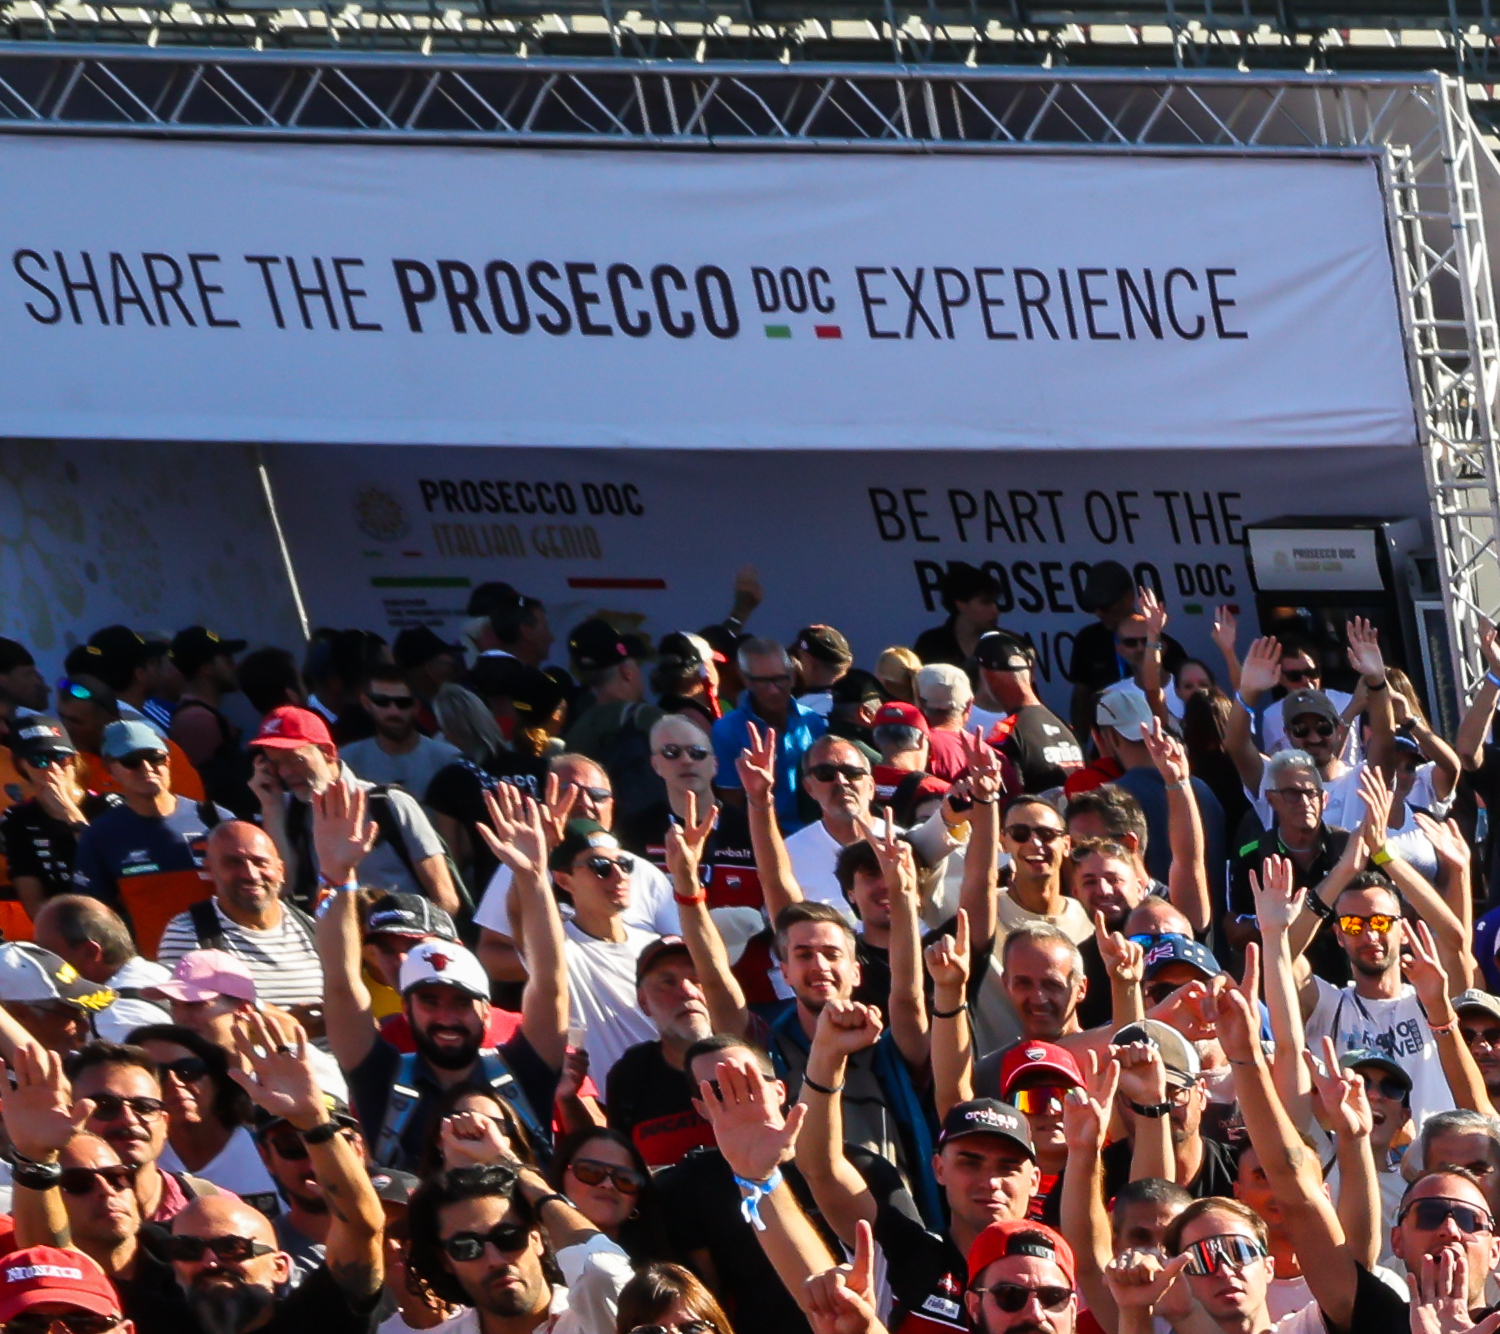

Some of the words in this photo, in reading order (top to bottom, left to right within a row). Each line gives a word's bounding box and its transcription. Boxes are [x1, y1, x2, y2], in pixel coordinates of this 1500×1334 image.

[13, 249, 240, 328] SHARE
[245, 255, 383, 332] THE
[392, 258, 740, 340] PROSECCO
[751, 266, 836, 315] DOC
[855, 266, 1249, 341] EXPERIENCE
[418, 478, 578, 515] PROSECCO
[584, 482, 645, 517] DOC
[867, 488, 938, 542] BE
[951, 490, 1066, 545] PART
[1085, 491, 1141, 546] OF
[1153, 491, 1247, 547] THE
[1174, 562, 1236, 599] DOC
